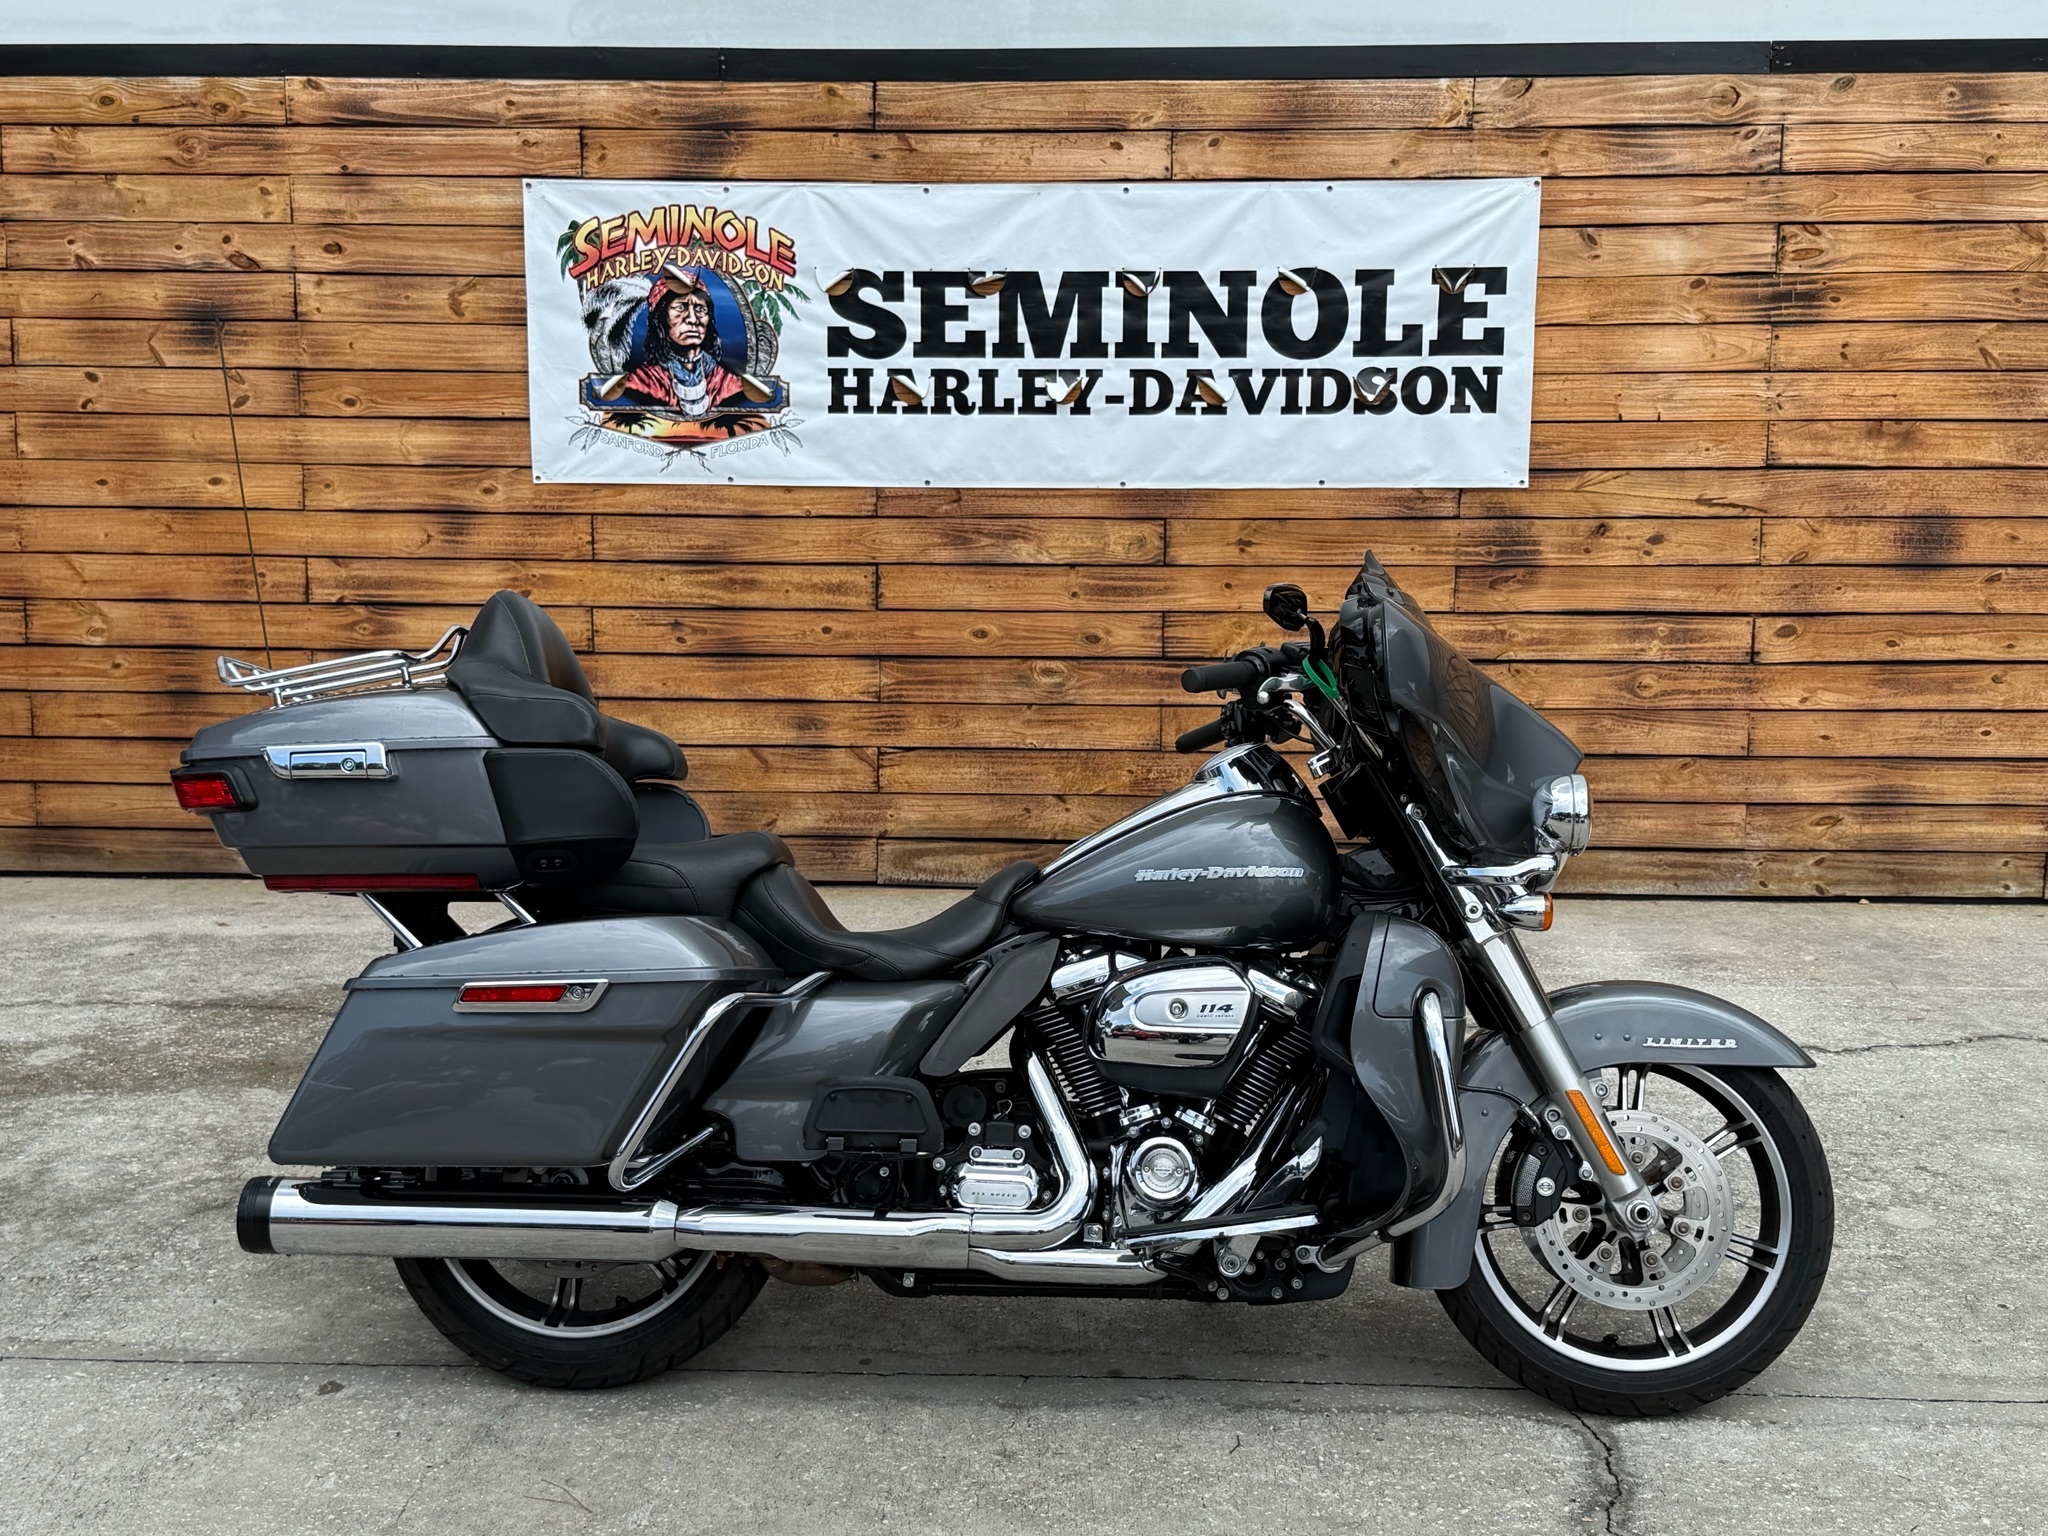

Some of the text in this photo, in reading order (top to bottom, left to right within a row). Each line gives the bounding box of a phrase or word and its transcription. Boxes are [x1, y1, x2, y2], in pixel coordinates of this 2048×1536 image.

[569, 204, 797, 277] SEMINOLE
[586, 246, 785, 292] HARLEY-DAVIDSON
[826, 266, 1508, 360] SEMINOLE
[827, 365, 1503, 416] HARLEY-DAVIDSON
[710, 433, 770, 459] FLORIDA
[1134, 865, 1305, 883] Harley-Davidson
[1199, 1003, 1235, 1013] 114
[1642, 1037, 1738, 1048] LIMITED
